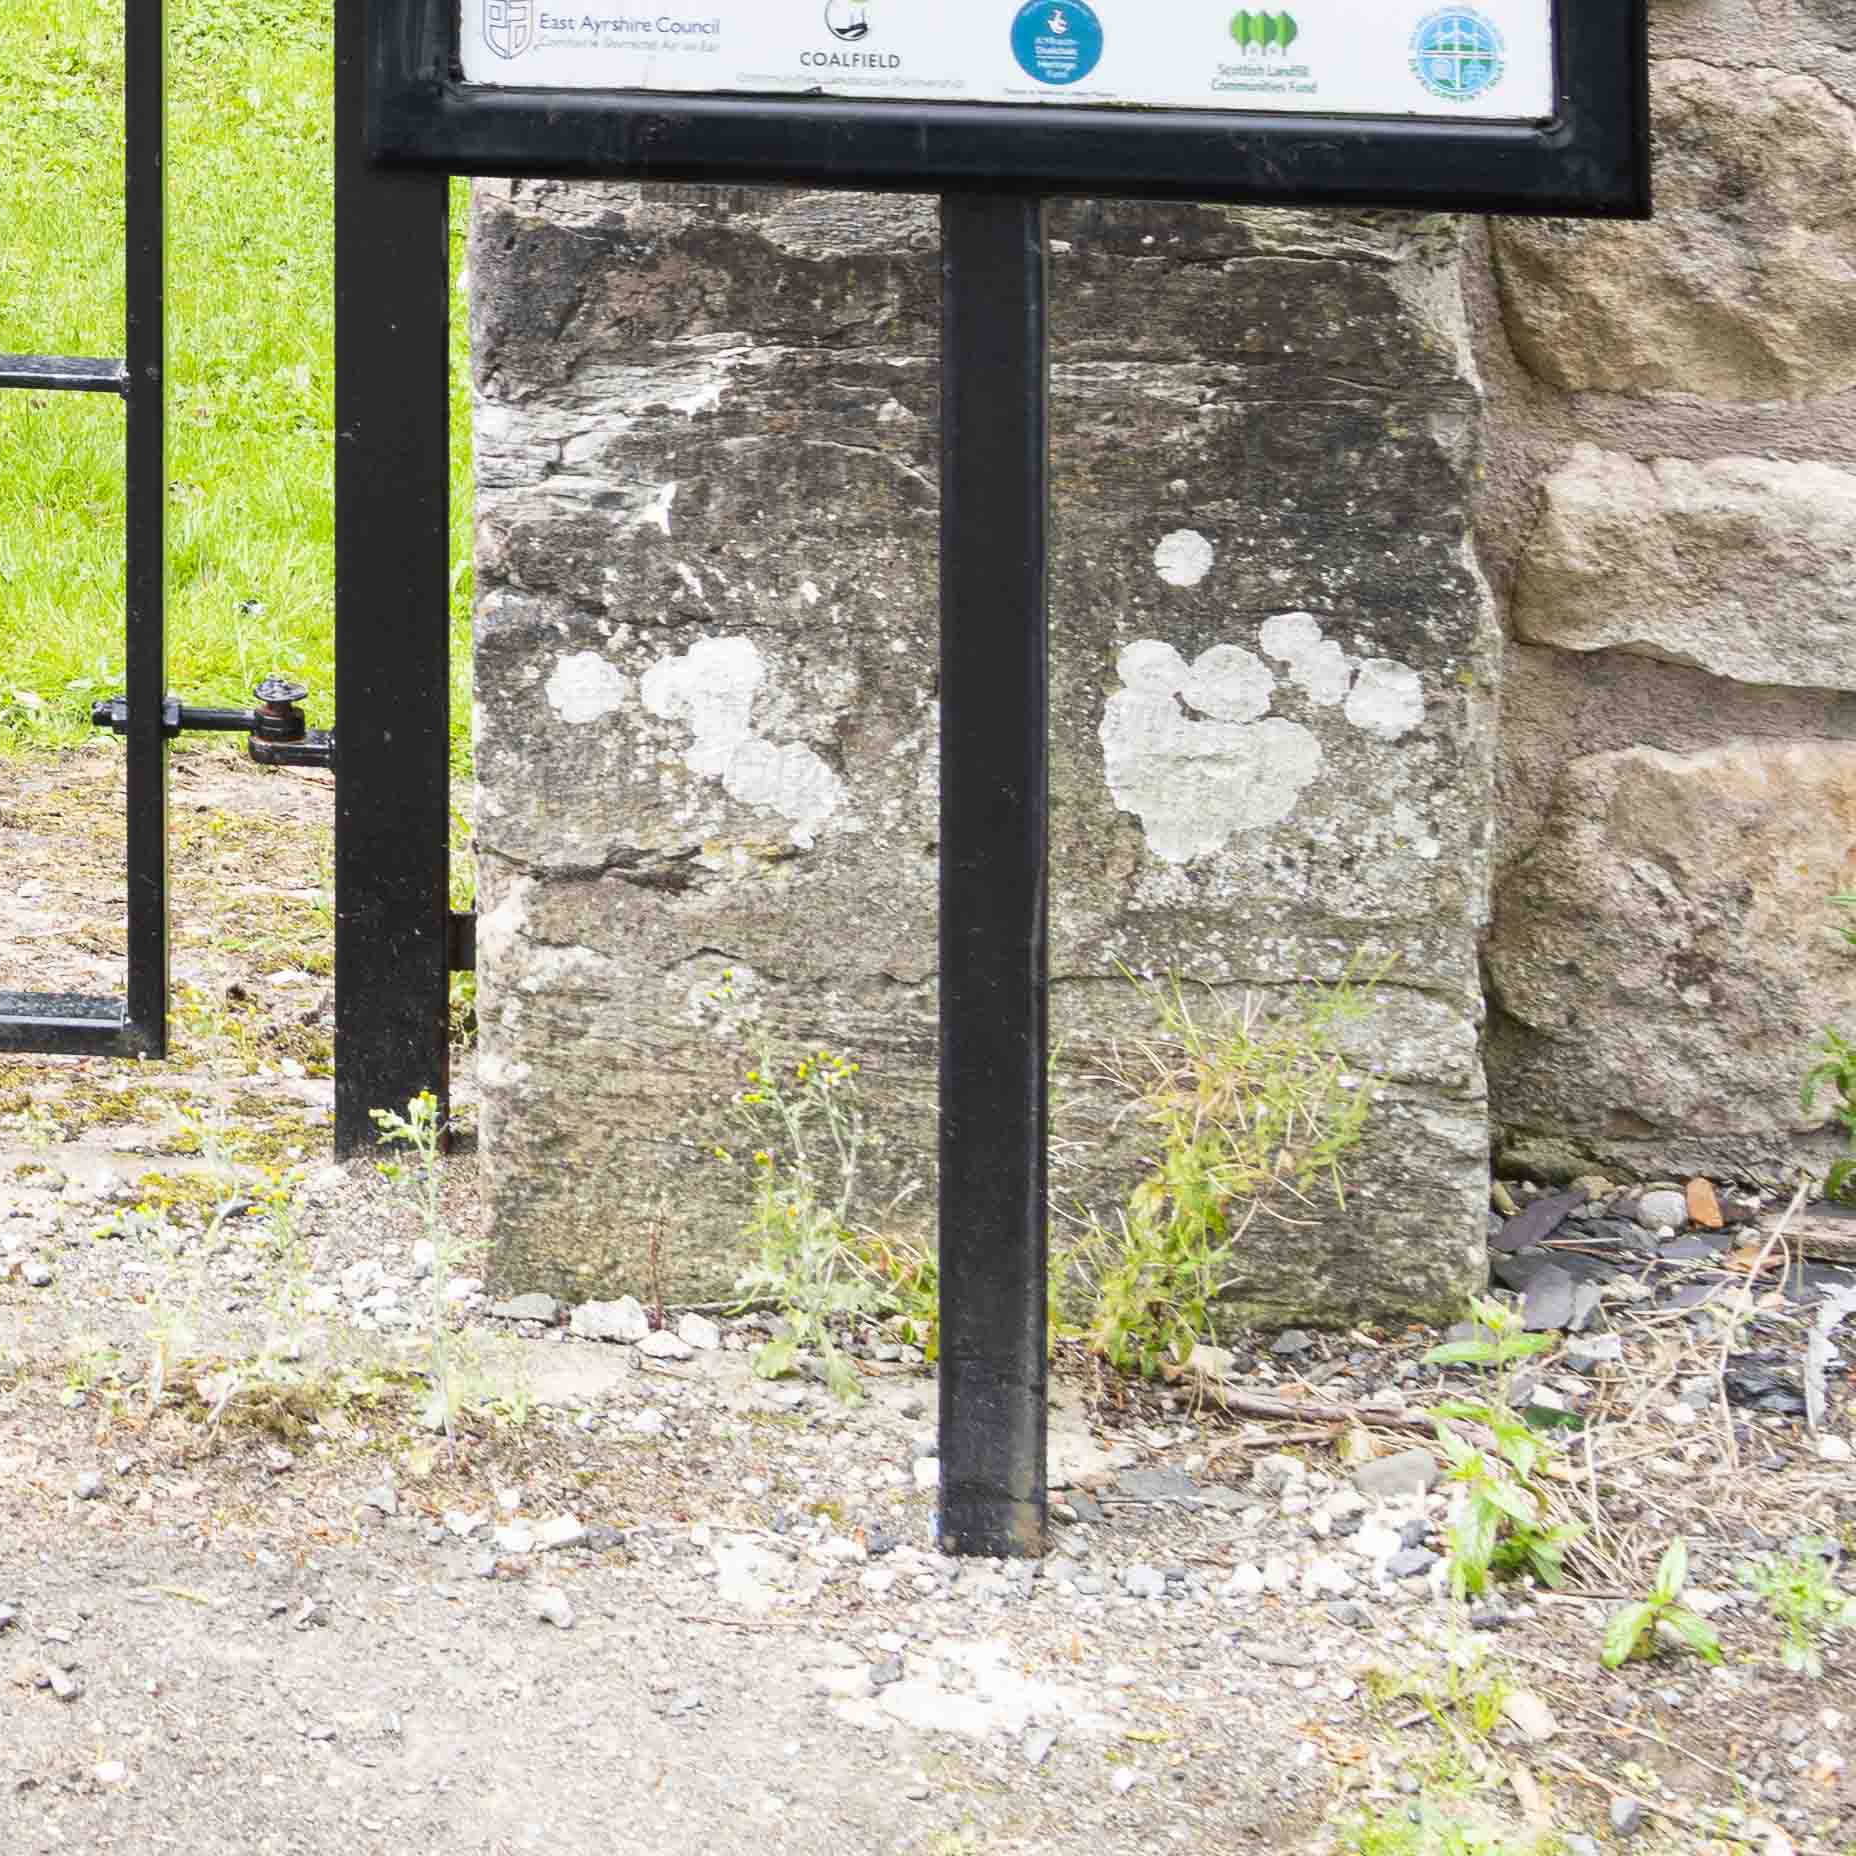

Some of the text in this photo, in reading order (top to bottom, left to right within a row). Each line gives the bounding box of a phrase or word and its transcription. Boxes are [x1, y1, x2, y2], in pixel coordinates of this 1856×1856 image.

[540, 12, 720, 35] East Ayrshire Council
[800, 51, 900, 69] COALFIELD
